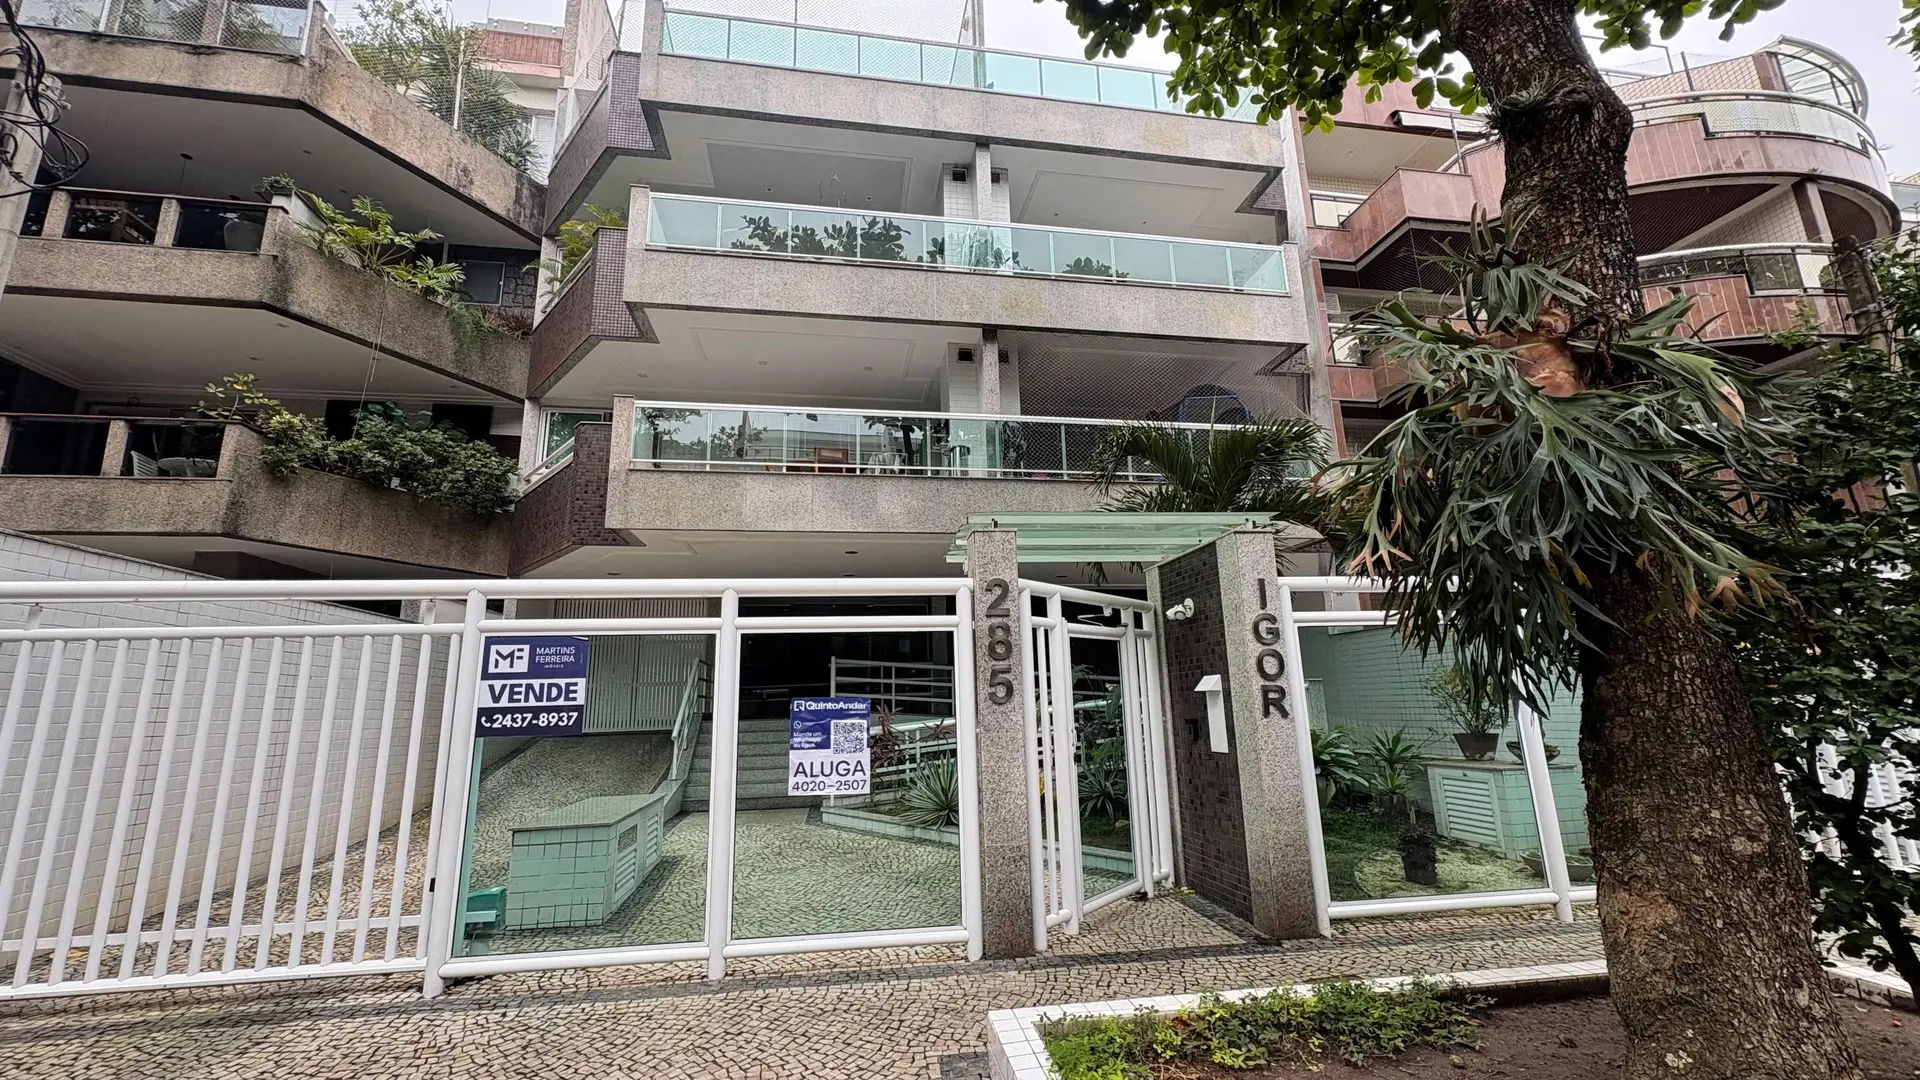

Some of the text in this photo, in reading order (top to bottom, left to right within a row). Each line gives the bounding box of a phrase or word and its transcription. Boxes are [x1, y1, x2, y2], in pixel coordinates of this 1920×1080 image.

[985, 578, 1013, 704] 285
[1253, 578, 1288, 718] IGOR
[536, 646, 576, 655] MARTINS
[535, 655, 575, 663] FERREIRA
[488, 682, 578, 704] VENDE
[806, 701, 866, 710] QuintoAndar
[492, 712, 578, 728] 2437-8937
[793, 760, 867, 778] ALUGA
[792, 780, 867, 792] 4020-2507
